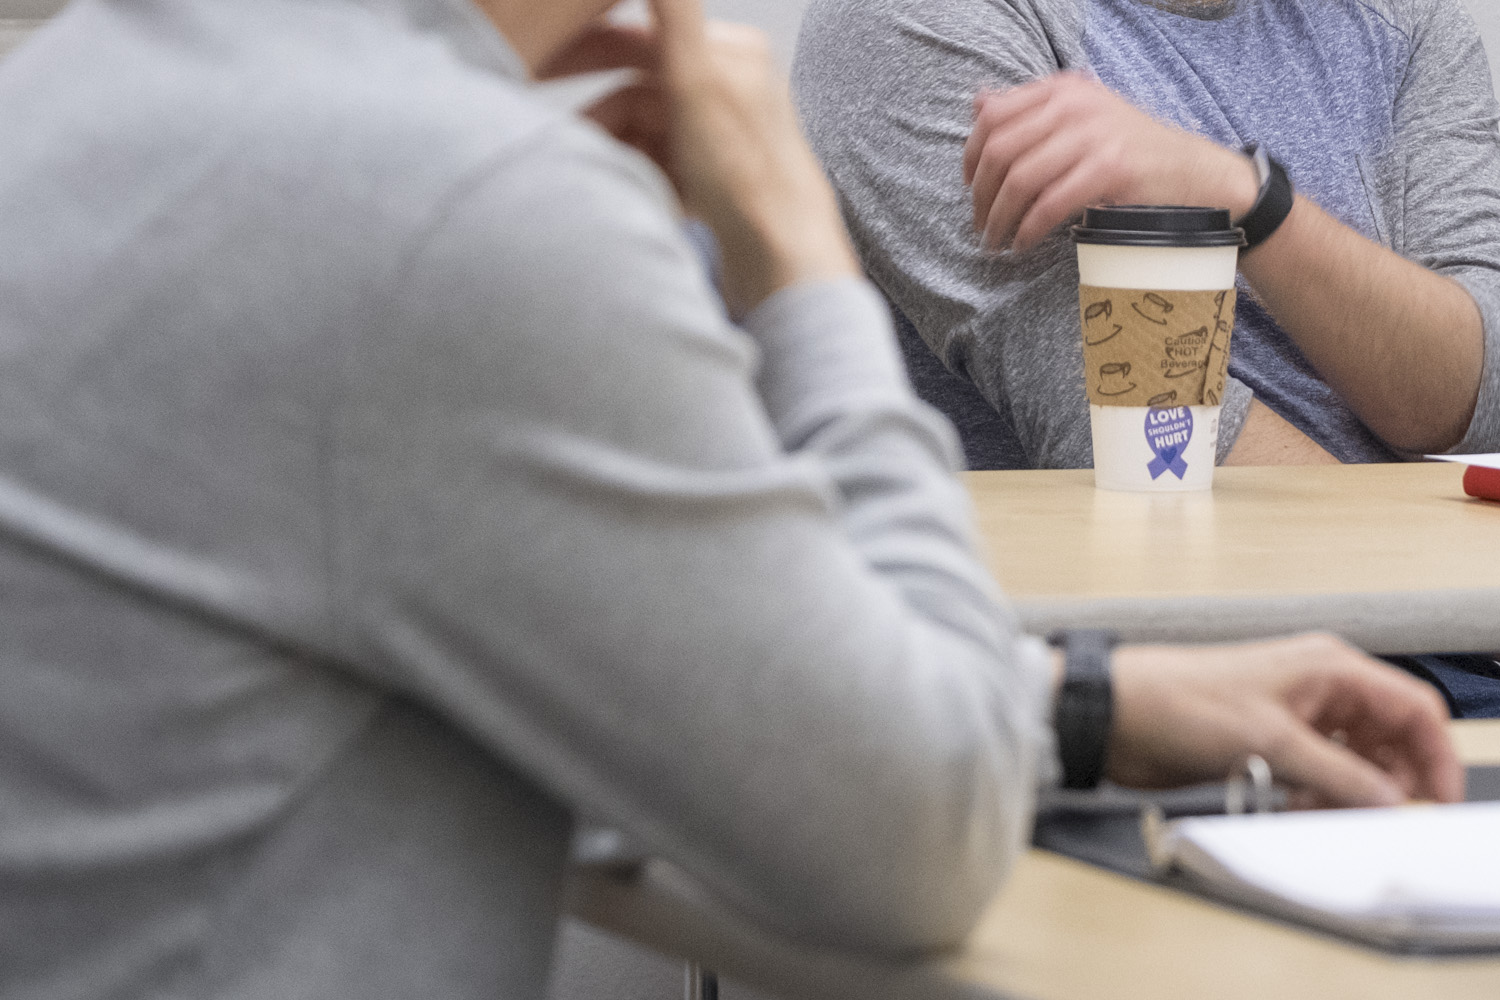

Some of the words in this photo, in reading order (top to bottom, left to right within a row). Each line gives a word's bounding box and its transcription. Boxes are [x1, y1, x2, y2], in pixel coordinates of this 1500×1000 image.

[1174, 347, 1199, 357] HOT
[1149, 406, 1185, 425] LOVE
[1147, 418, 1191, 436] SHOULDN'T
[1155, 429, 1188, 449] HURT
